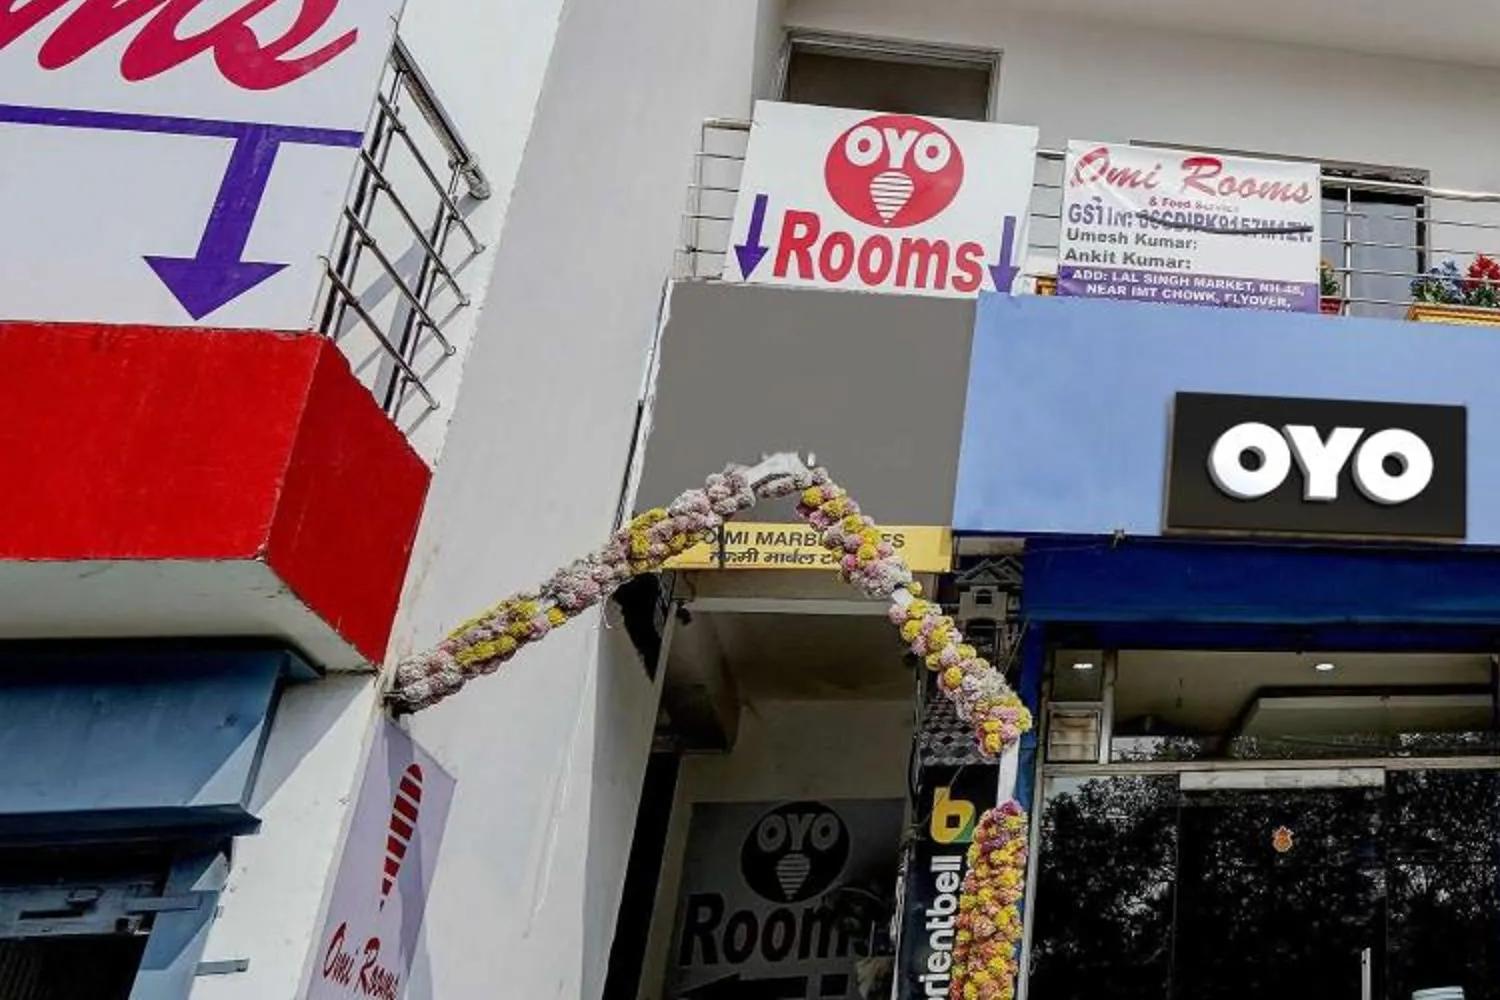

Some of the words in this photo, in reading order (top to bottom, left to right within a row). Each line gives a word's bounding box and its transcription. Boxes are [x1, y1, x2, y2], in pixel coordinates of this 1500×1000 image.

[844, 124, 952, 169] OYO
[1180, 156, 1313, 204] Rooms
[773, 209, 986, 293] Rooms
[1064, 248, 1118, 265] Ankit
[1066, 227, 1129, 246] Umesh
[1073, 269, 1108, 281] ADD:
[1112, 271, 1139, 284] LAL
[1143, 273, 1189, 287] SINGH
[1087, 283, 1127, 296] NEAR
[1131, 285, 1158, 298] IMT
[1207, 421, 1435, 506] OYO
[755, 530, 830, 548] MARBL
[757, 812, 840, 853] OYO
[678, 892, 851, 966] Room
[918, 855, 963, 1000] rientbell
